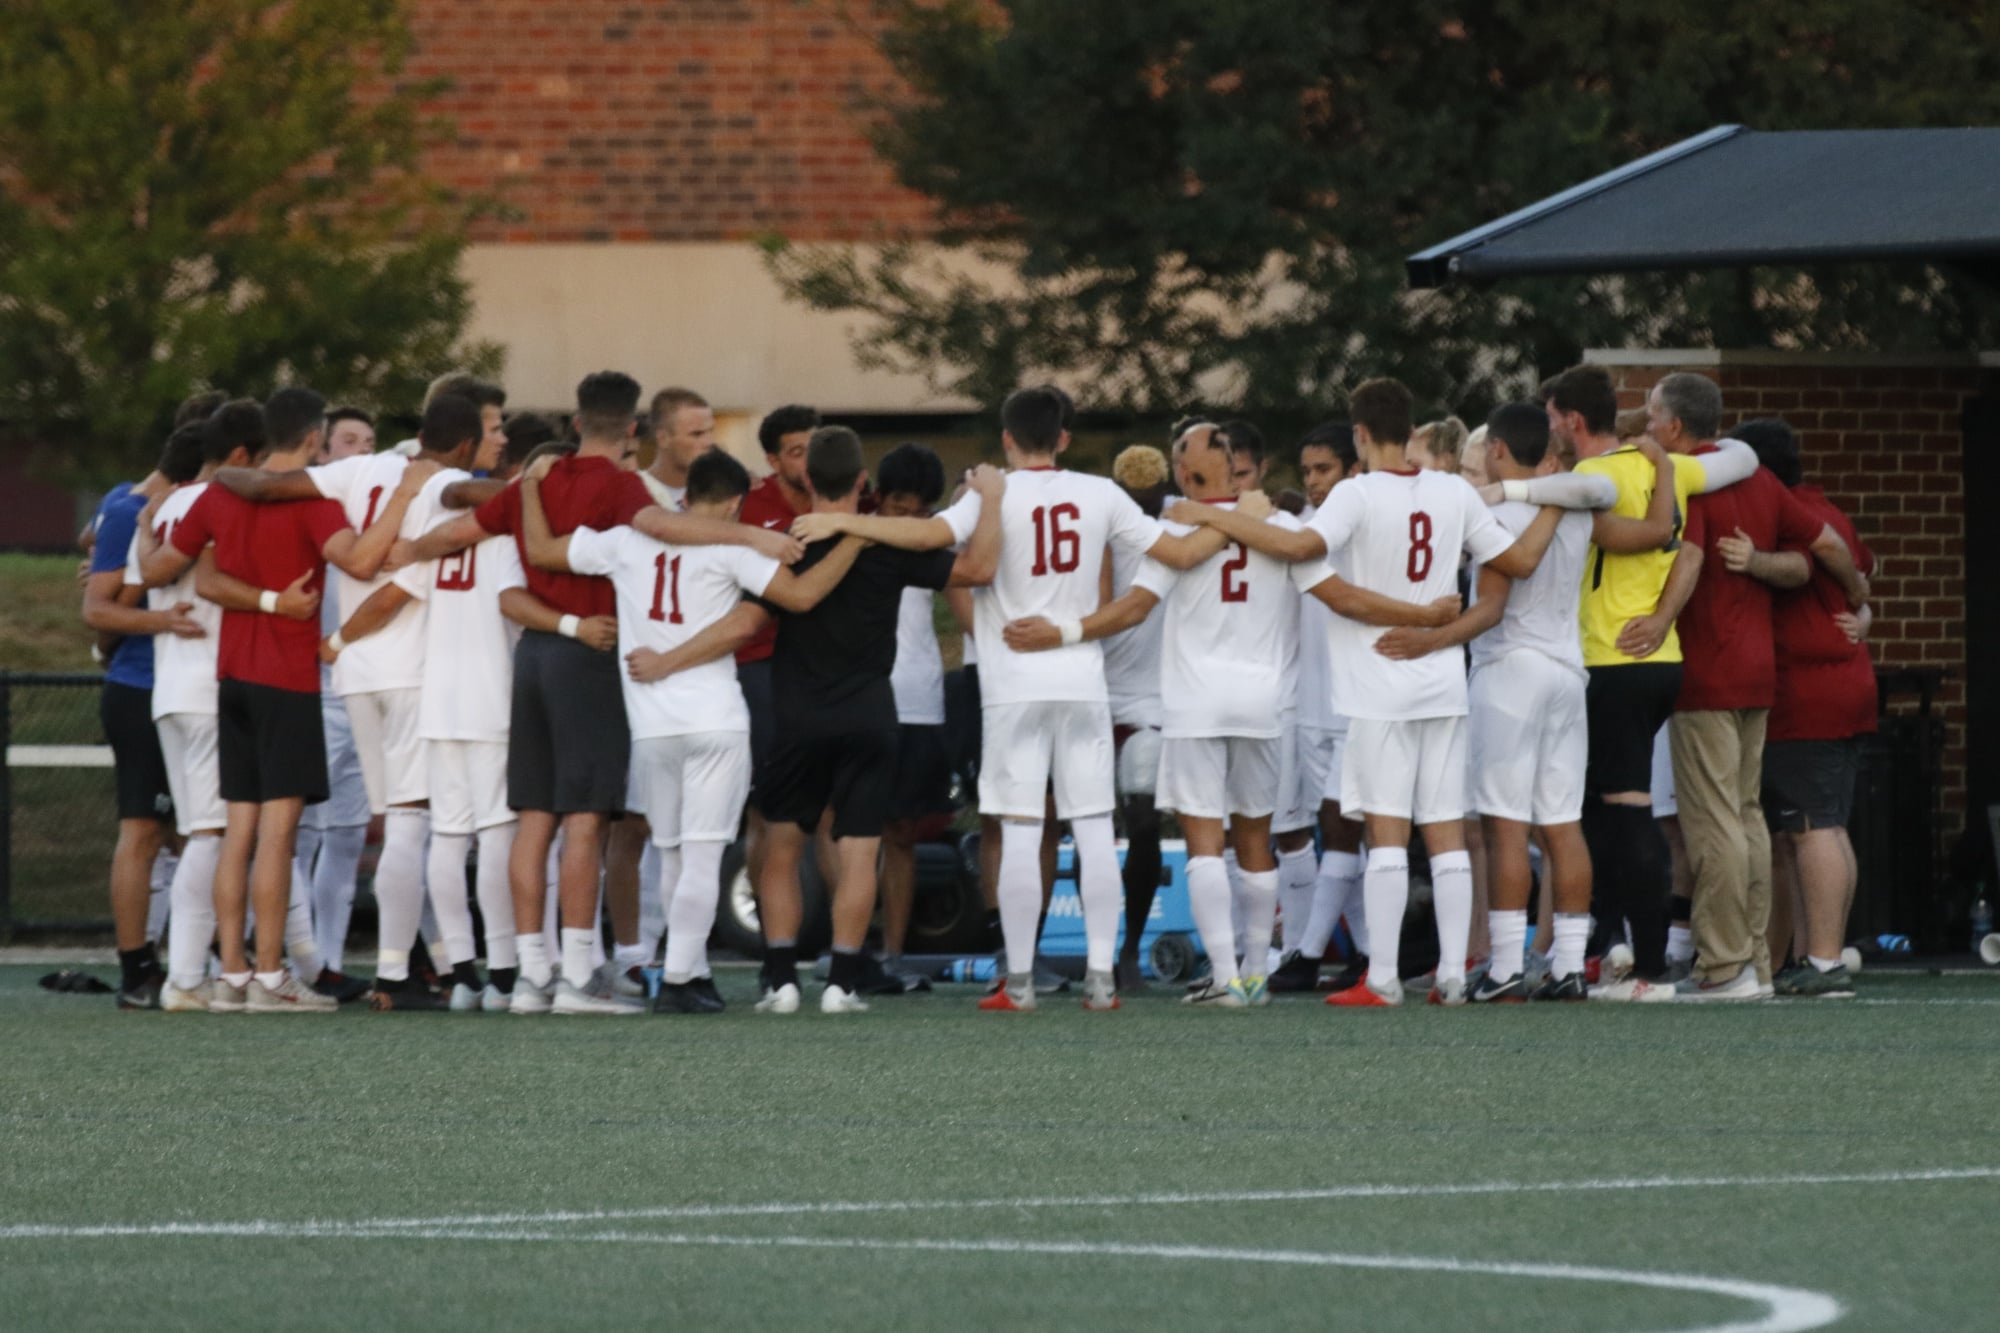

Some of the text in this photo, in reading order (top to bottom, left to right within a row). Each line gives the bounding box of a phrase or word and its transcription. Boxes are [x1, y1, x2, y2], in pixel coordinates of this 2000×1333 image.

[1031, 502, 1080, 576] 16
[1221, 542, 1248, 602] 2
[1407, 510, 1432, 582] 8
[648, 551, 684, 624] 11
